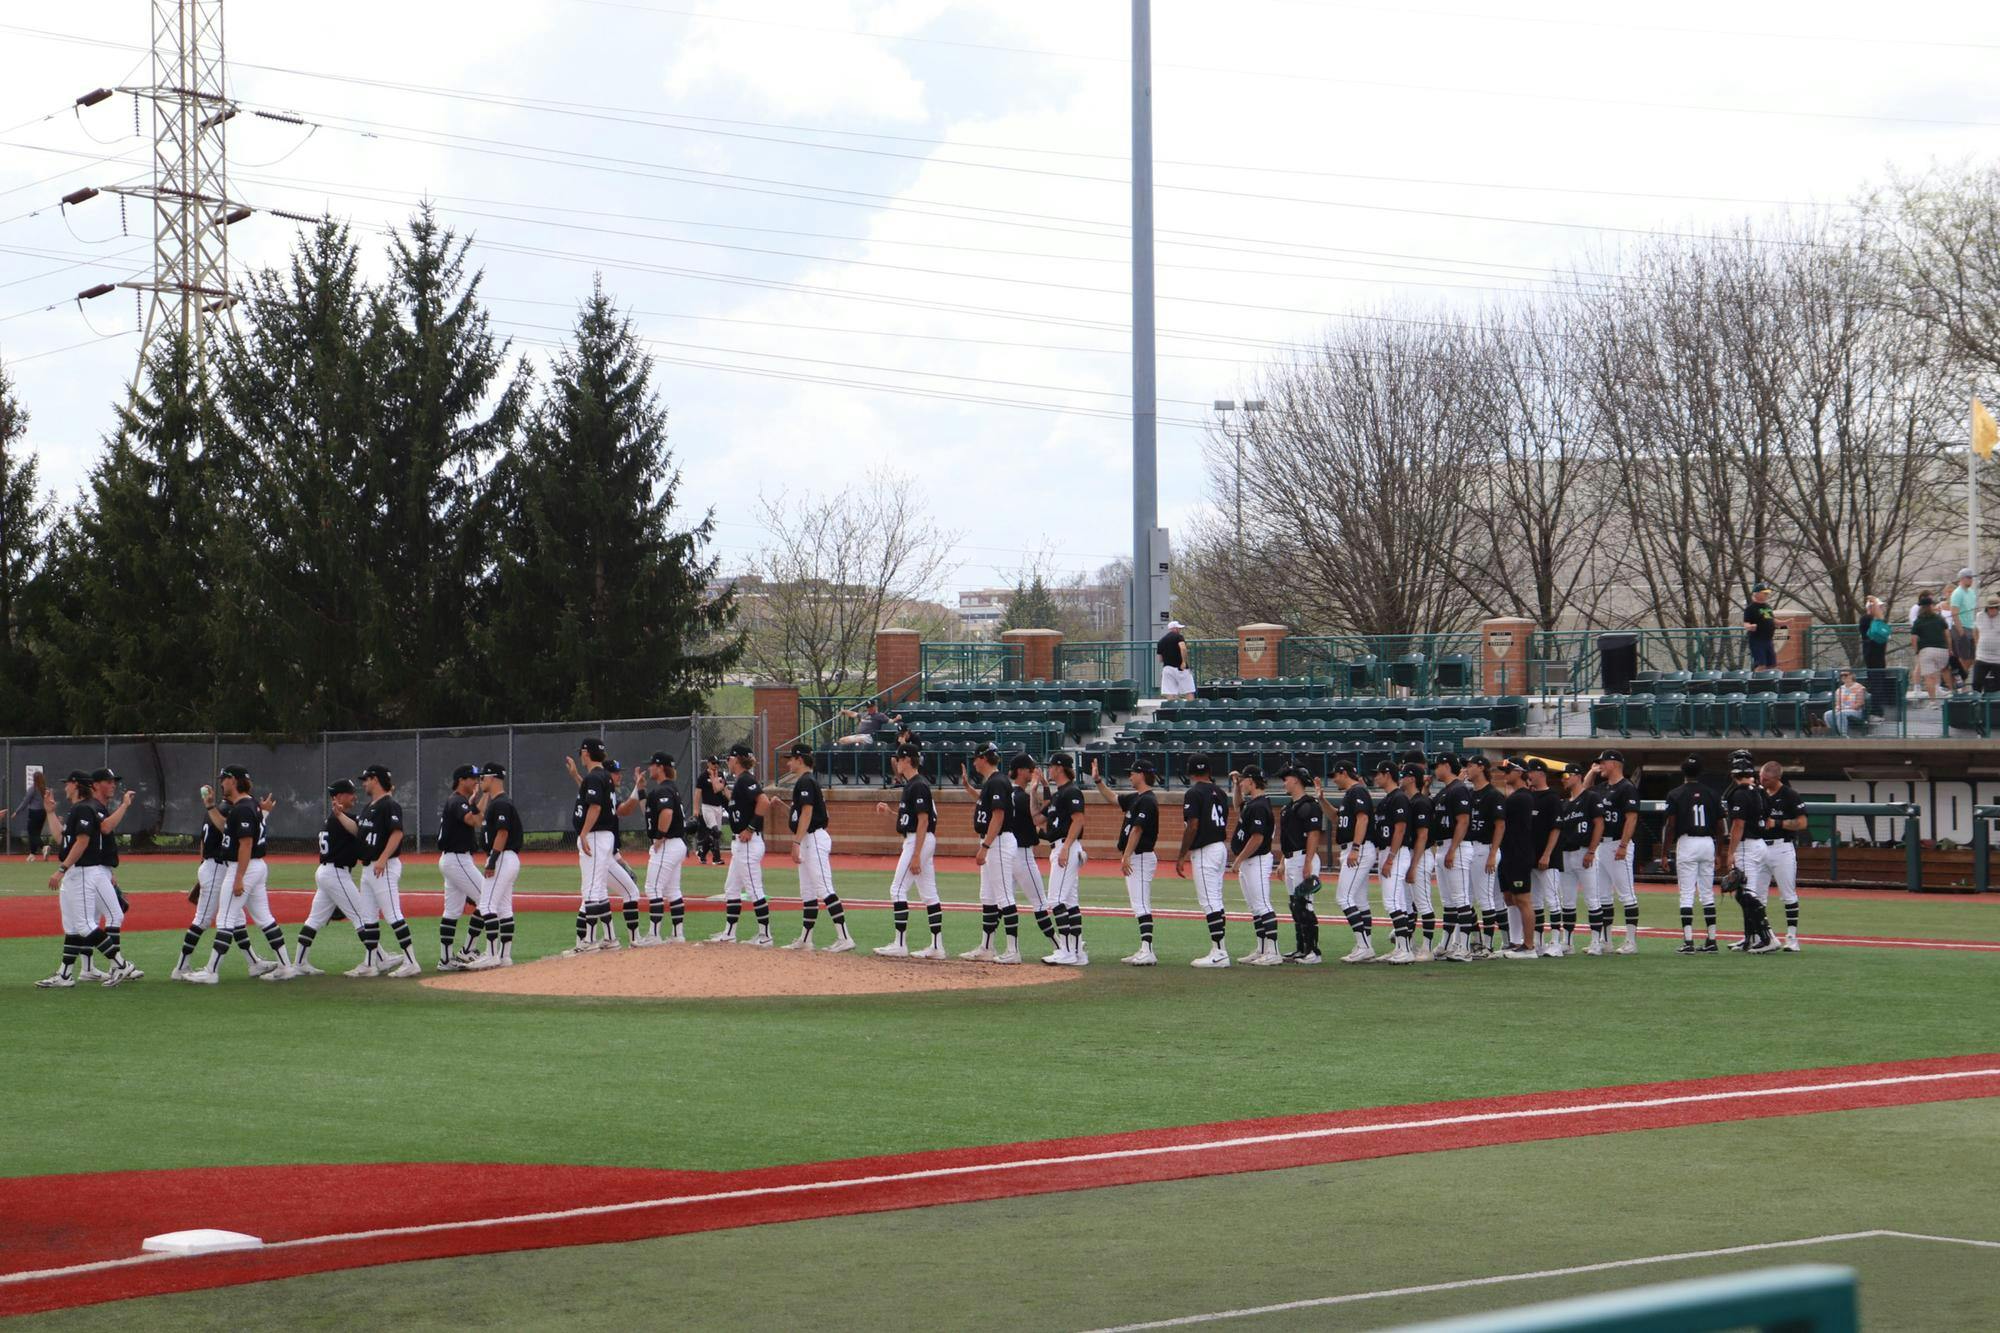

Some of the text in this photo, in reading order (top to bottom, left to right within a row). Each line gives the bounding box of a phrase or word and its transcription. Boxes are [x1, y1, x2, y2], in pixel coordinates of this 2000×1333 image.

[976, 810, 987, 824] 22
[1210, 803, 1226, 827] 42
[1337, 815, 1349, 828] 30
[1604, 810, 1618, 823] 33
[1692, 803, 1706, 827] 11
[1577, 821, 1588, 833] 19
[365, 832, 377, 845] 41
